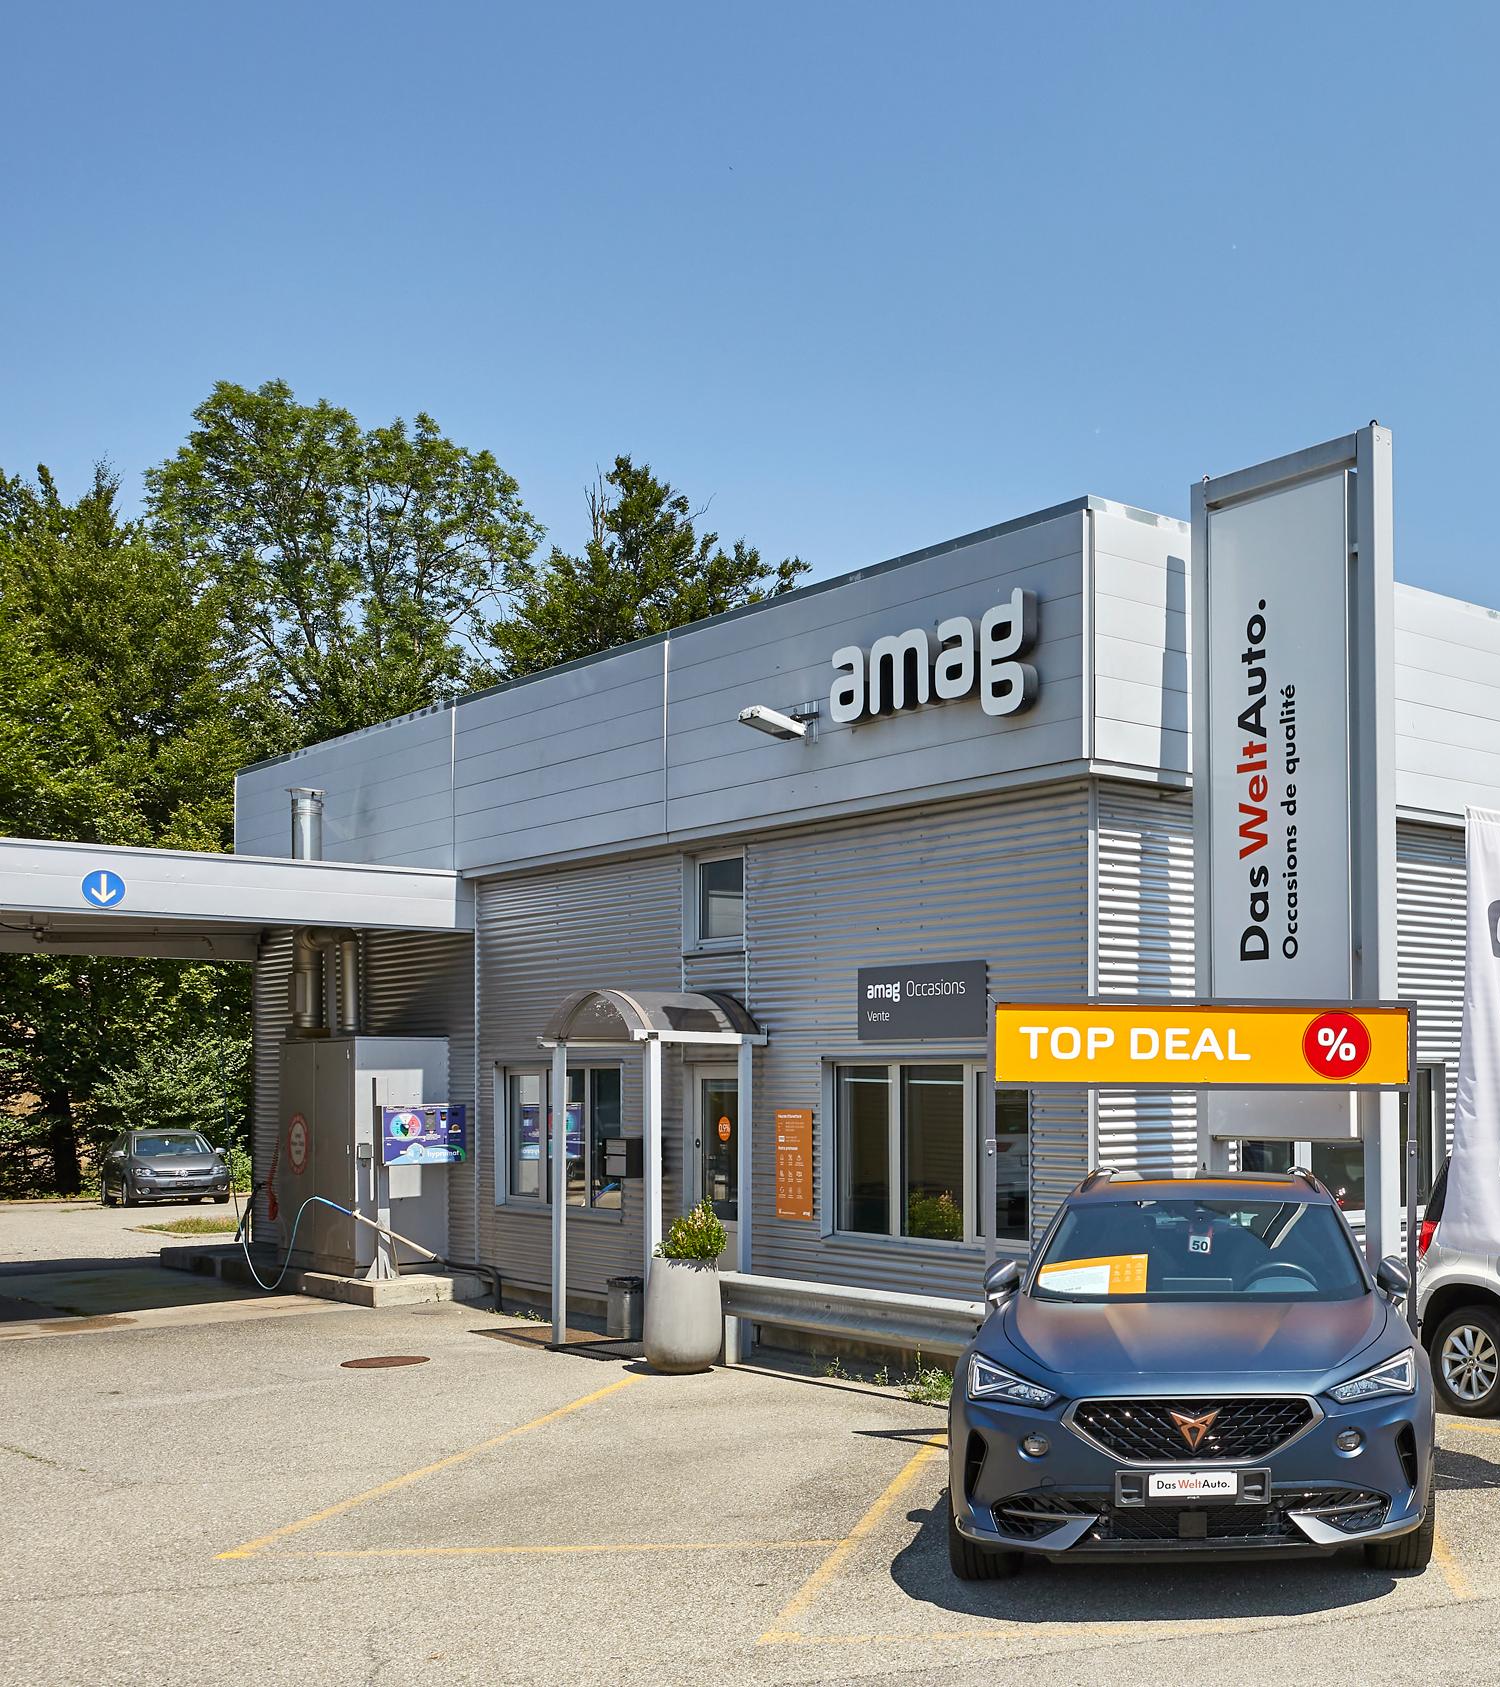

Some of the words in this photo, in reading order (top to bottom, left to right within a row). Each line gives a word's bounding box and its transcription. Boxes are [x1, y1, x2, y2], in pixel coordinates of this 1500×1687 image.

[829, 587, 1026, 723] amag
[1236, 598, 1269, 860] WeltAuto.
[1279, 683, 1301, 776] qualité
[1280, 783, 1298, 817] de
[1282, 824, 1299, 960] Occasions
[1239, 865, 1270, 961] Das
[866, 981, 901, 1003] amag
[906, 978, 966, 997] Occasions
[866, 1010, 890, 1022] Vente
[1019, 1026, 1115, 1060] TOP
[1129, 1027, 1252, 1061] DEAL
[1317, 1027, 1357, 1062] %
[1191, 1240, 1209, 1251] 50
[1156, 1480, 1177, 1490] Das
[1177, 1479, 1231, 1489] WeltAuto.
